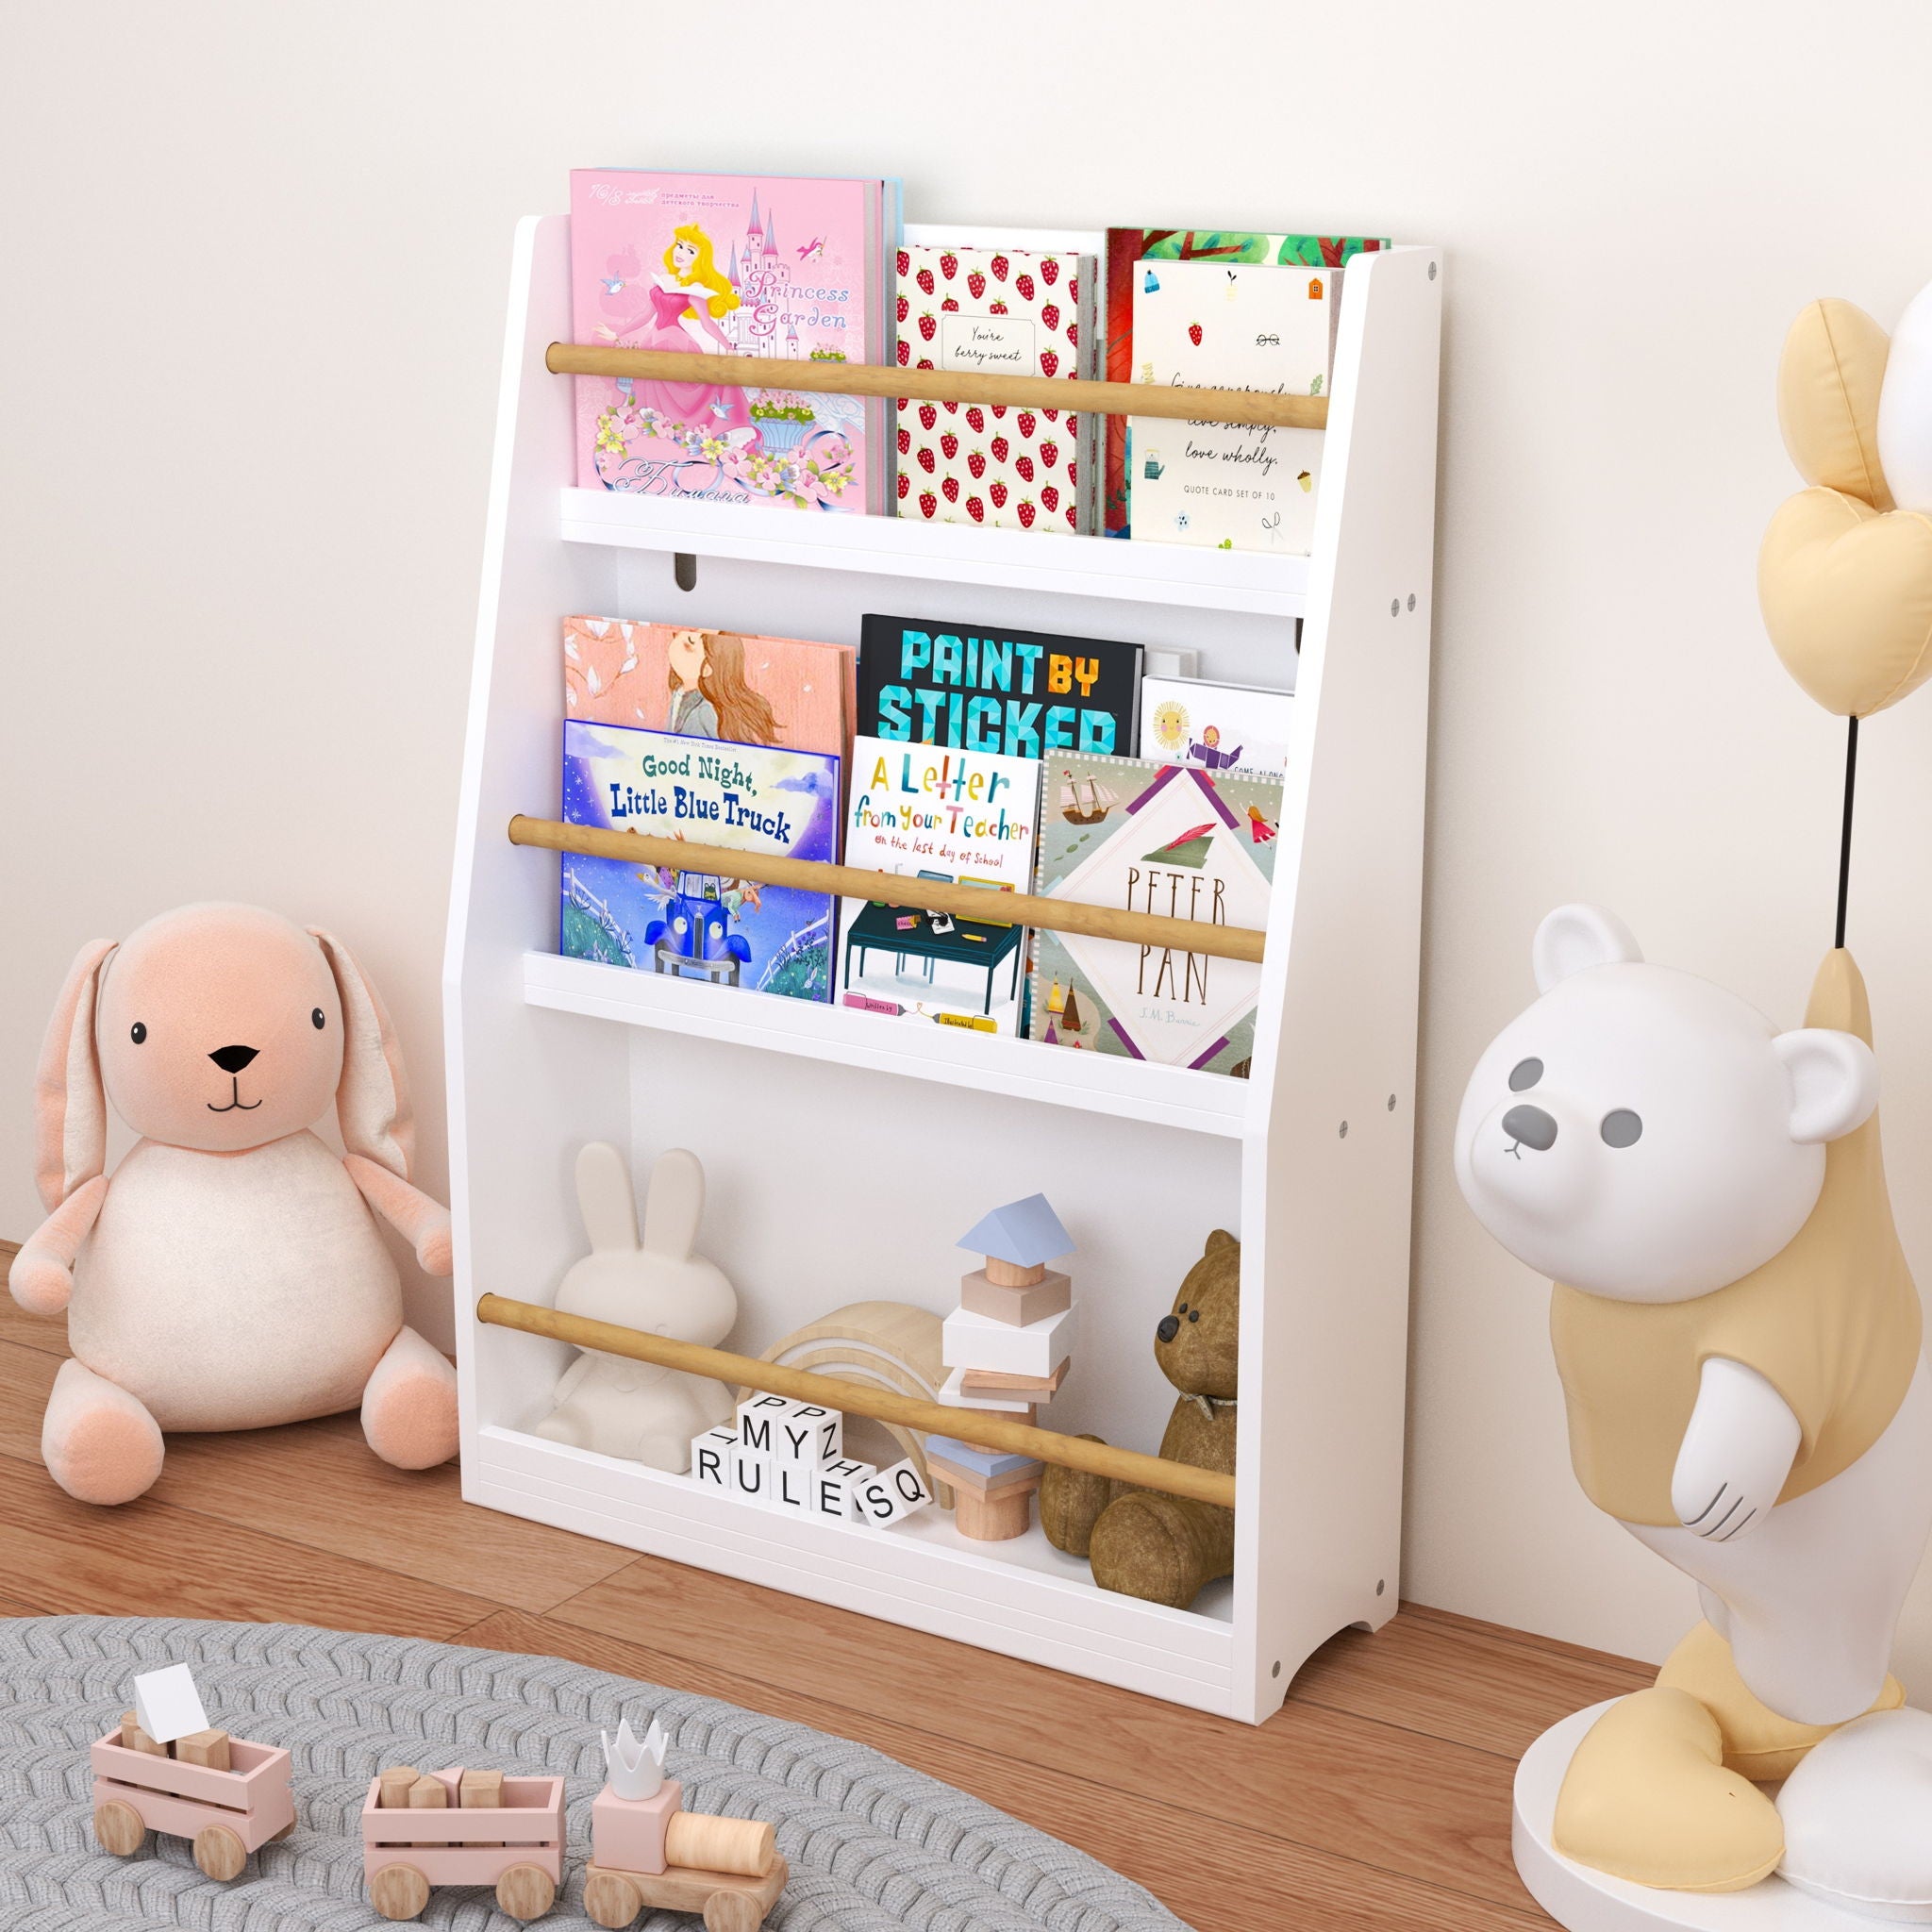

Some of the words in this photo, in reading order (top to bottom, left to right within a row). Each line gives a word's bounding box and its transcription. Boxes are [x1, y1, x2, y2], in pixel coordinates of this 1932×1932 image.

[745, 270, 849, 302] Princess
[748, 304, 847, 337] Garden
[955, 345, 988, 366] berry
[989, 349, 1022, 361] sweet
[1185, 441, 1218, 459] love
[1222, 444, 1278, 476] wholly.
[1183, 485, 1209, 495] QUOTE
[1212, 487, 1233, 497] CARD
[1236, 490, 1249, 499] SET
[1252, 491, 1263, 500] OF
[1266, 491, 1275, 501] 10
[901, 629, 1043, 695] PAINT
[1047, 654, 1100, 698] BY
[642, 755, 691, 777] Good
[698, 757, 758, 797] Night,
[870, 757, 890, 791] A
[901, 753, 1010, 804] Letter
[609, 783, 669, 817] Little
[674, 786, 720, 820] Blue
[723, 792, 791, 843] Truck
[854, 795, 897, 828] from
[946, 806, 1029, 841] Teacher
[874, 835, 887, 845] on
[891, 836, 908, 851] the
[912, 837, 934, 855] last
[939, 844, 956, 863] day
[959, 852, 972, 864] of
[1127, 866, 1225, 925] PETER
[1136, 943, 1208, 1007] PAN
